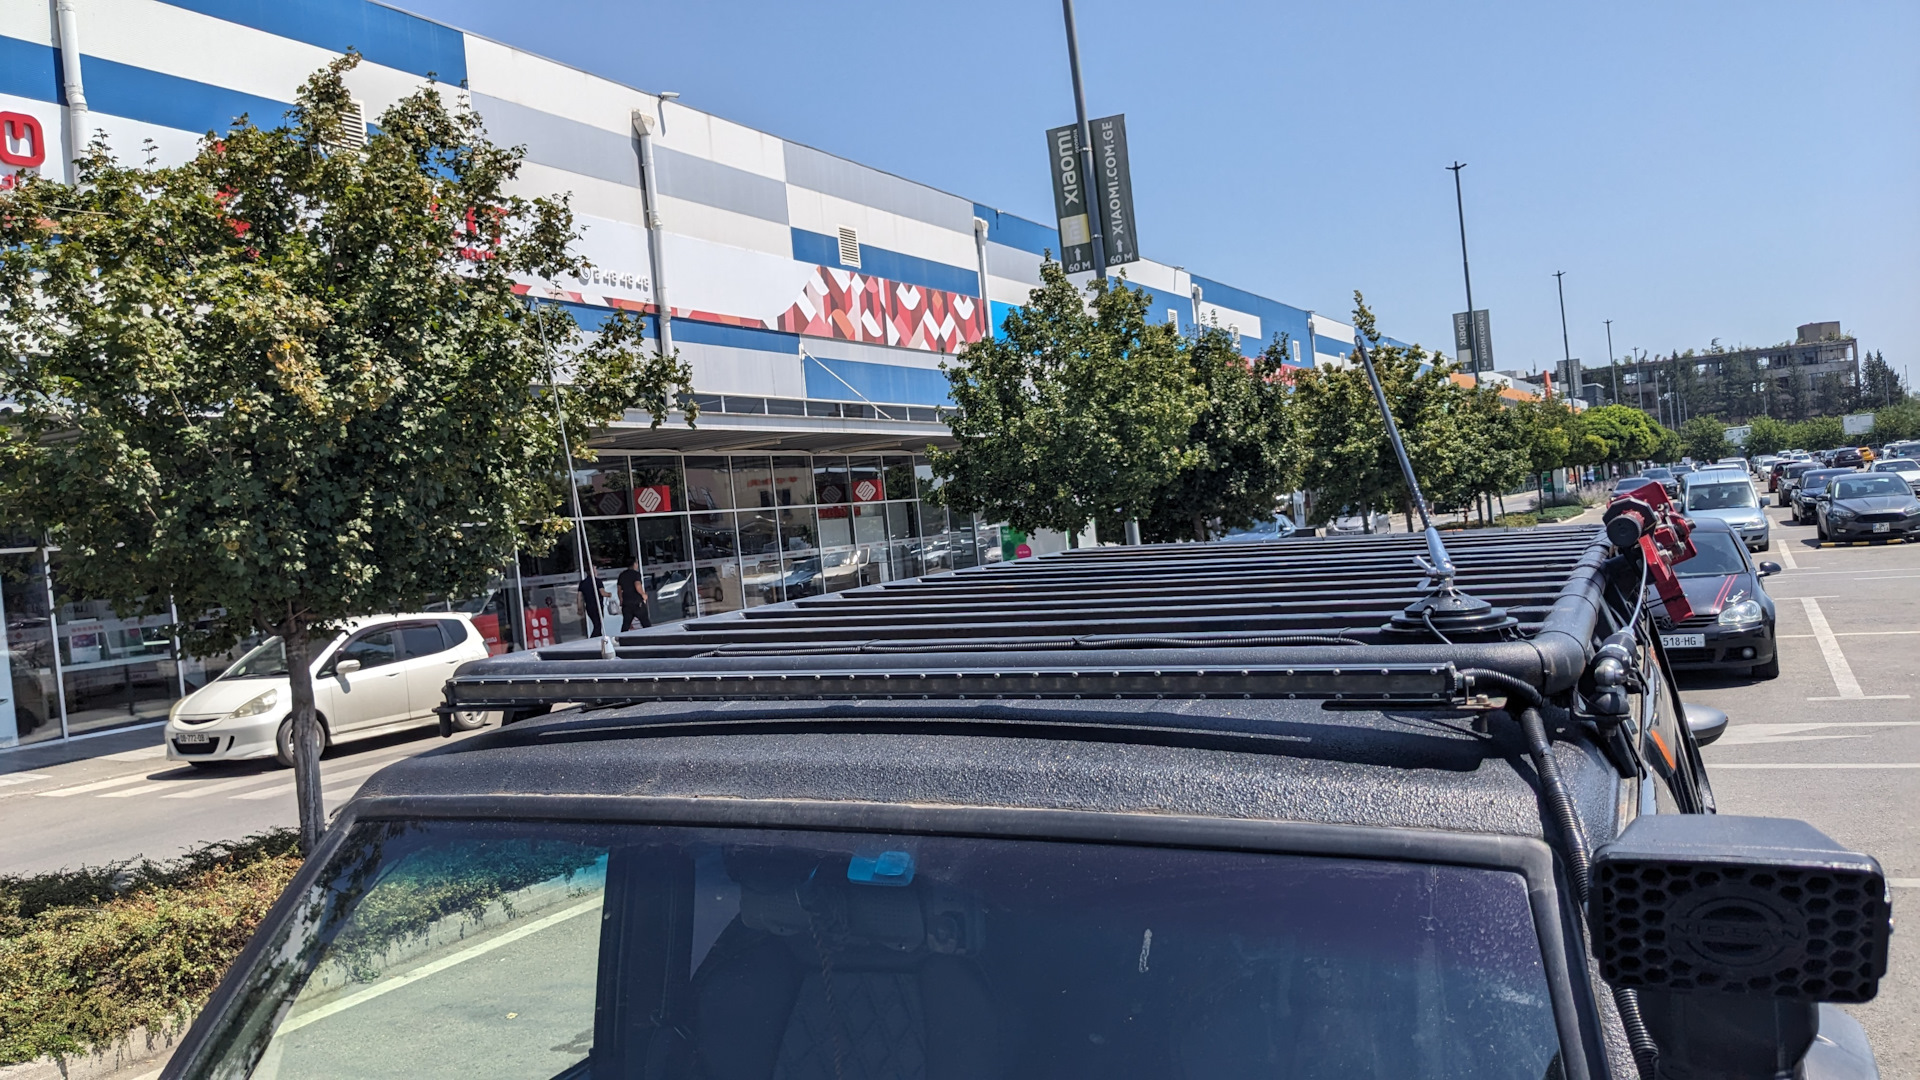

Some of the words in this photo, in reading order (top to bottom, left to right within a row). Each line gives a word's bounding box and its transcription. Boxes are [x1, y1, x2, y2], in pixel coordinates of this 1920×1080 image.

[1057, 130, 1079, 206] xiaomi
[1102, 121, 1123, 236] XIAOMI.COM.GE
[1068, 263, 1080, 272] 60
[1082, 261, 1091, 270] M
[1110, 255, 1122, 264] 60
[1124, 252, 1133, 262] M
[1671, 922, 1802, 940] NISSAN
